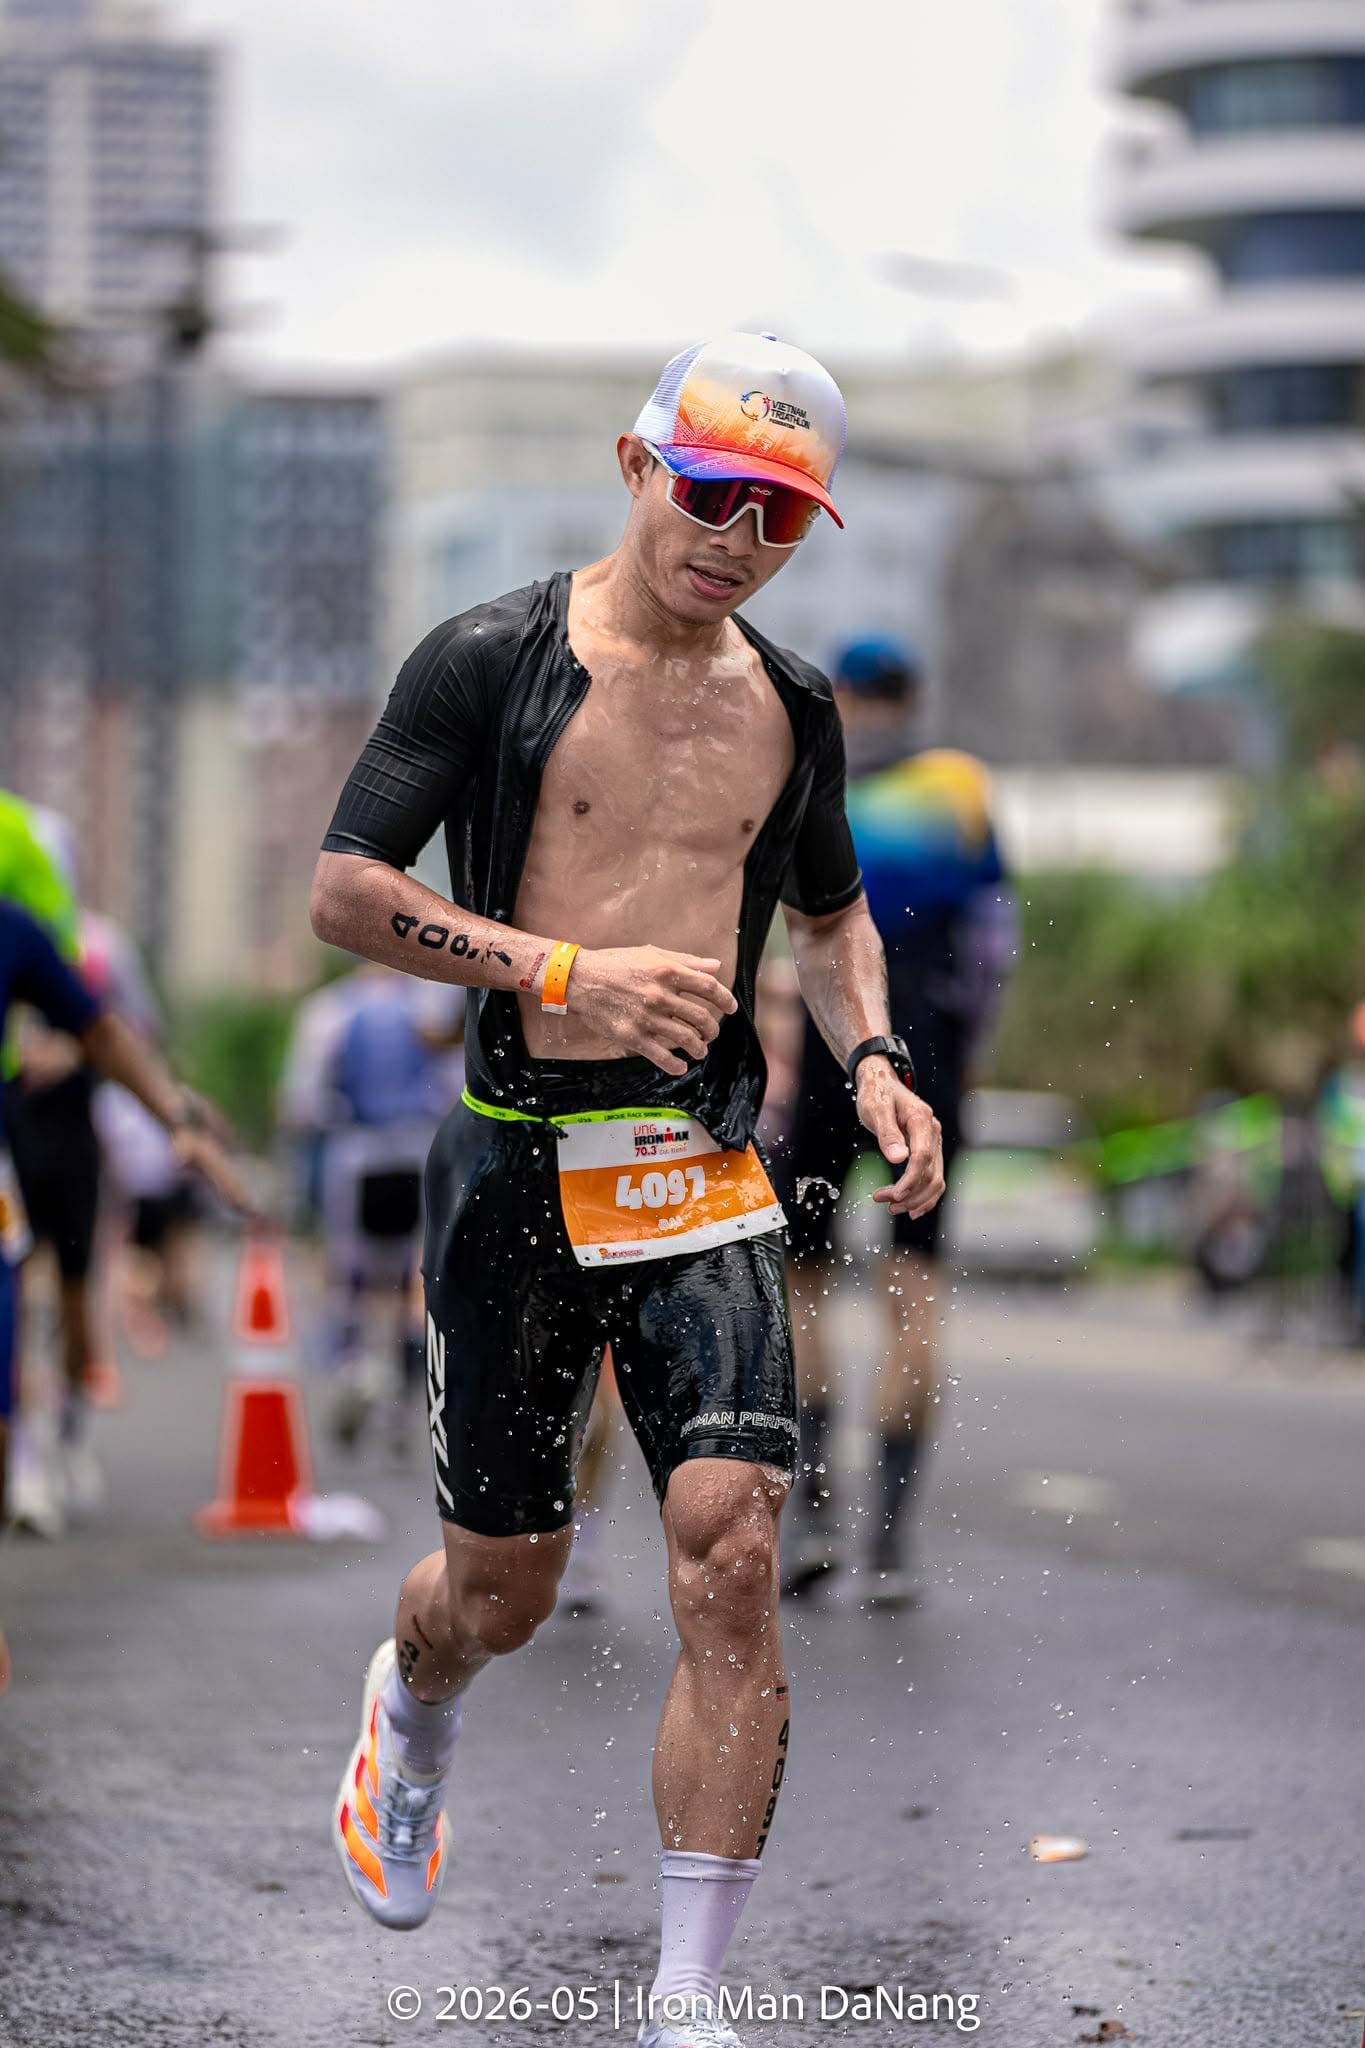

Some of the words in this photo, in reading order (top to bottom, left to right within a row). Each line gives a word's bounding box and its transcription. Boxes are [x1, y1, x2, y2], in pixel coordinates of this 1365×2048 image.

[771, 408, 810, 430] TRIATHLON
[772, 400, 807, 419] VIETNAM
[634, 1127, 689, 1146] IRONMAN
[635, 1145, 657, 1157] 70.3
[615, 1165, 706, 1210] 4097
